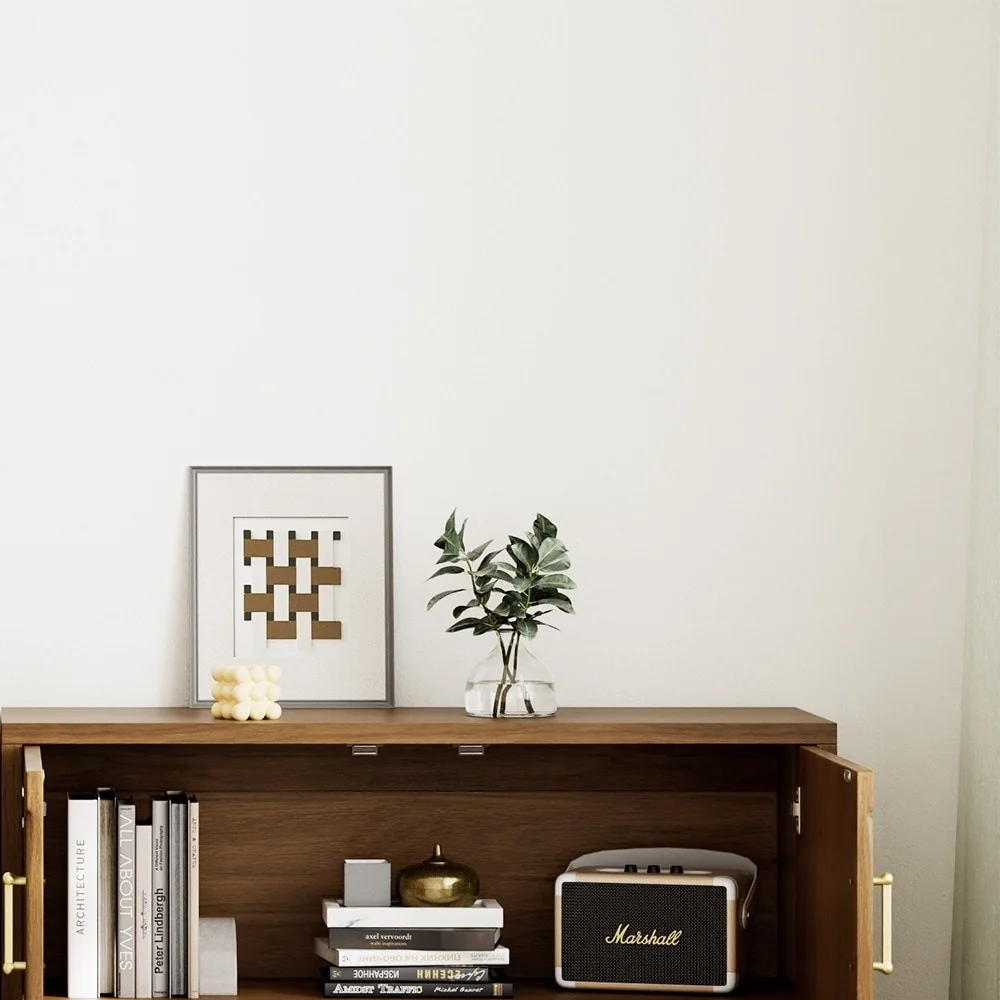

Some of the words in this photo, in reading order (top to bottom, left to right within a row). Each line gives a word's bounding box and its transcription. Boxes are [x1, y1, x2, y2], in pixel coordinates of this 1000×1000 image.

[119, 813, 133, 847] ALL
[75, 838, 86, 936] ARCHITECTURE
[119, 854, 133, 917] ABOUT
[154, 887, 167, 943] Lindbergh
[119, 925, 133, 970] YVES
[365, 932, 380, 940] axel
[380, 933, 413, 941] vervoordt
[605, 923, 683, 946] Marshall
[154, 946, 164, 975] Peter
[353, 969, 400, 979] ИЗБРАННОЕ
